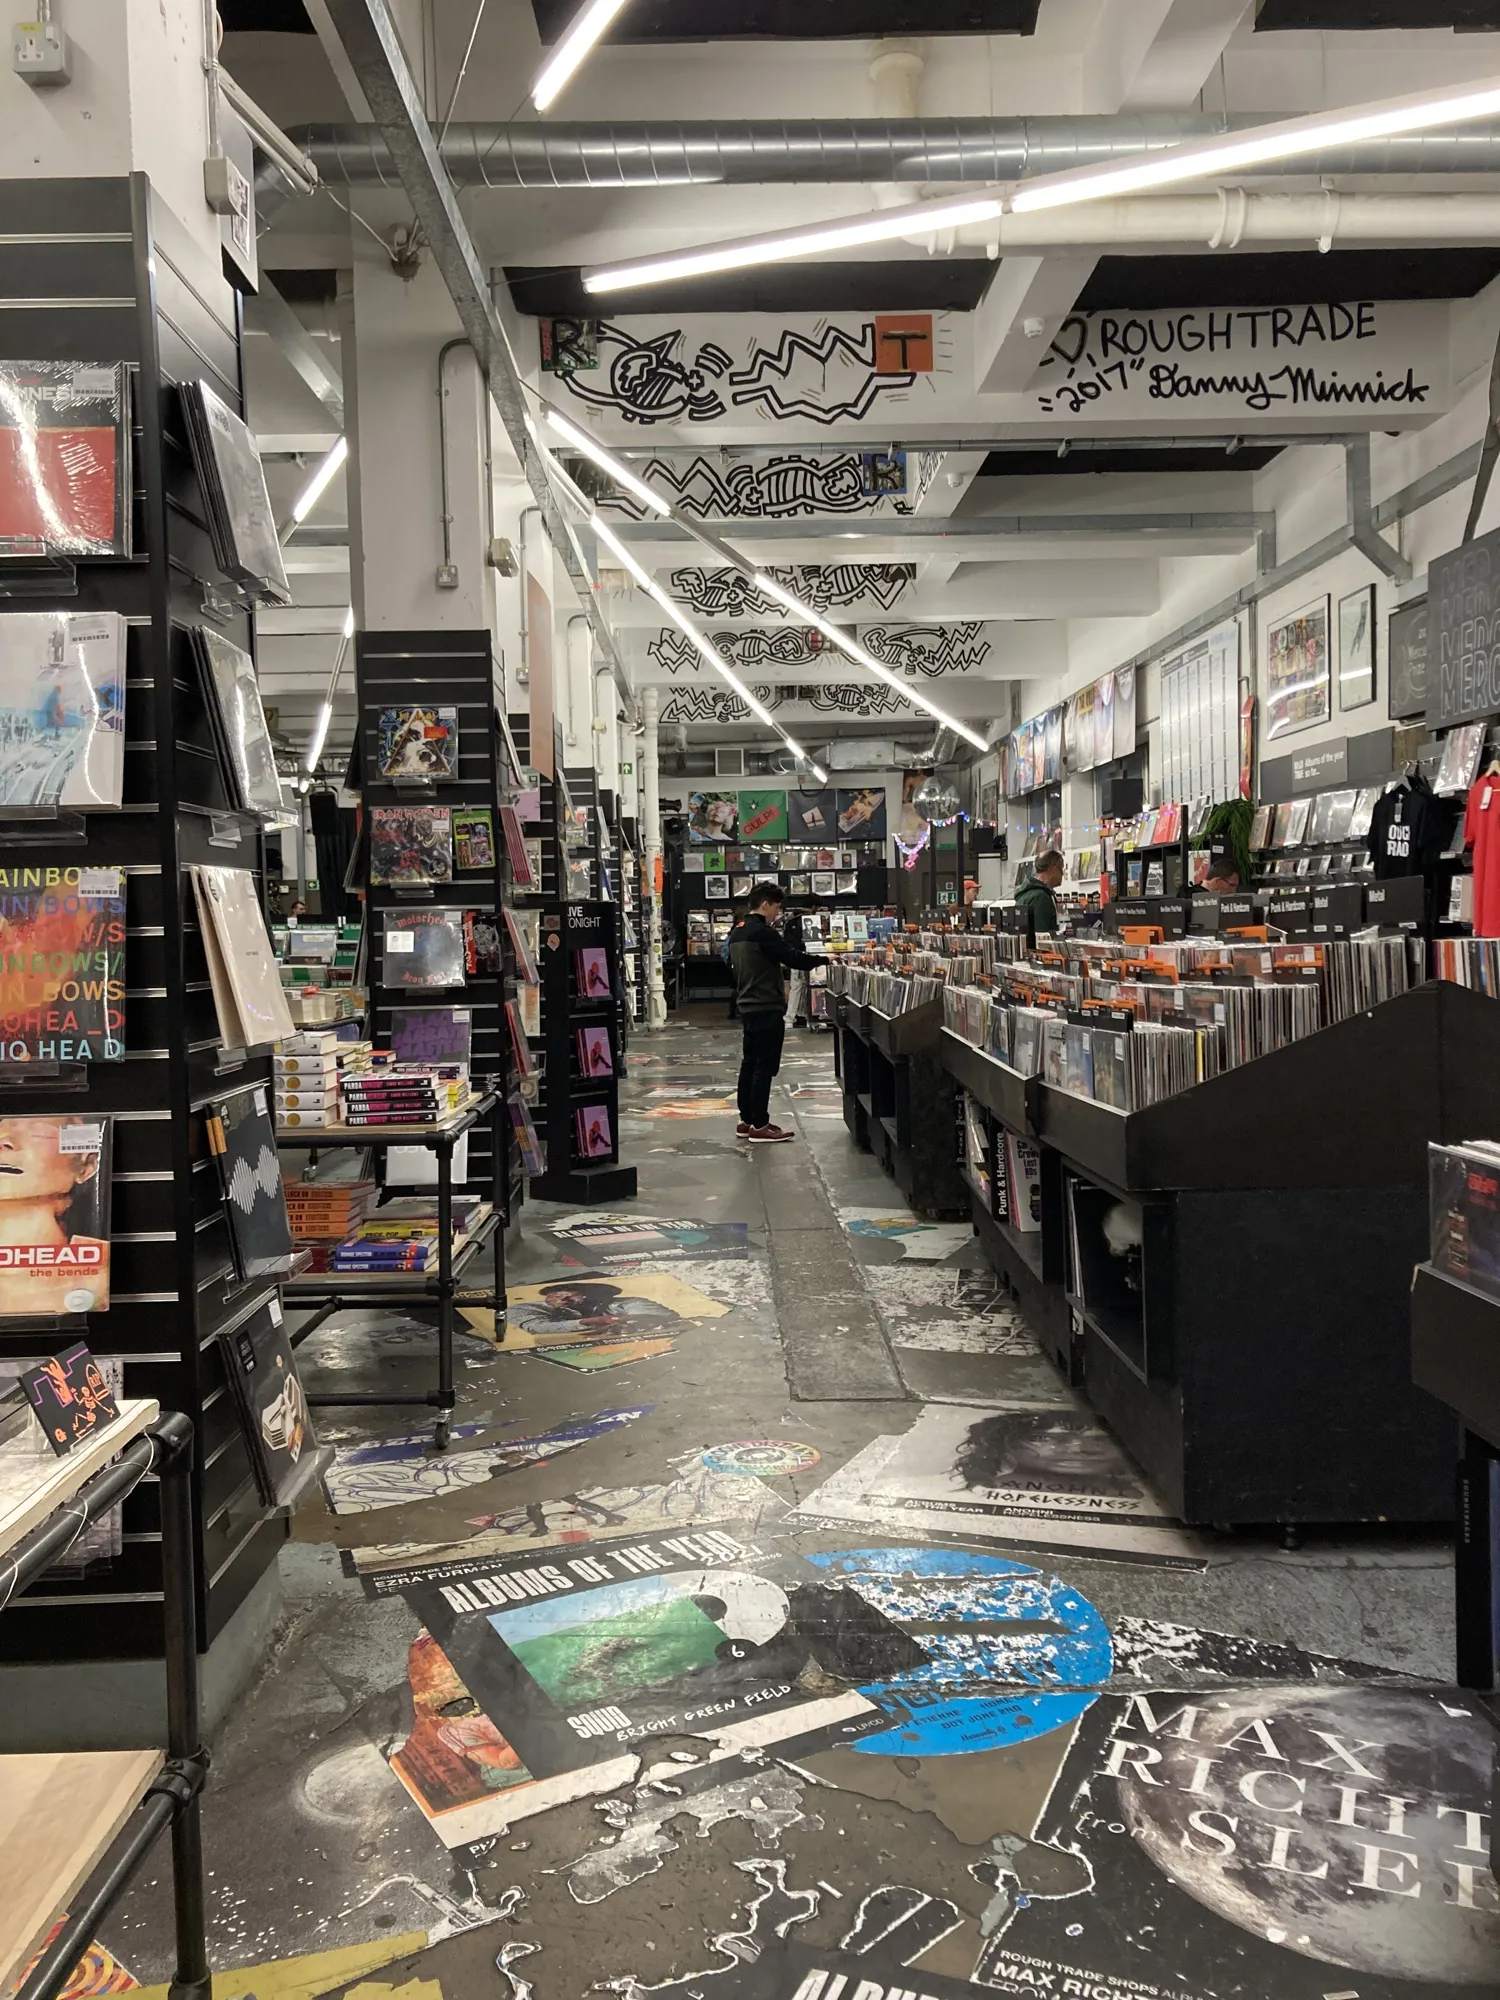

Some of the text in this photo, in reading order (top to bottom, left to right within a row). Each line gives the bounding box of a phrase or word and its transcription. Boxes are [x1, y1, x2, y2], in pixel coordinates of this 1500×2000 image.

[882, 331, 928, 370] T
[995, 1132, 1005, 1178] Hardcore
[998, 1189, 1008, 1215] Punk
[29, 1267, 99, 1277] the bends
[986, 1490, 1141, 1511] HOPELESSNESS
[374, 1574, 424, 1588] EZRA
[438, 1565, 575, 1614] ALBUMS
[567, 1556, 615, 1583] OF
[605, 1543, 675, 1574] THE
[659, 1530, 748, 1562] YEAR
[731, 1645, 746, 1658] 6
[566, 1705, 633, 1739] SQUID
[616, 1684, 792, 1742] BRIGHT GREEN FIELD
[1117, 1696, 1385, 1782] MAX
[993, 1961, 1057, 1989] MAX
[1000, 1949, 1052, 1970] ROUGH
[1056, 1963, 1106, 1982] TRADE
[1107, 1976, 1159, 1996] SHOPS
